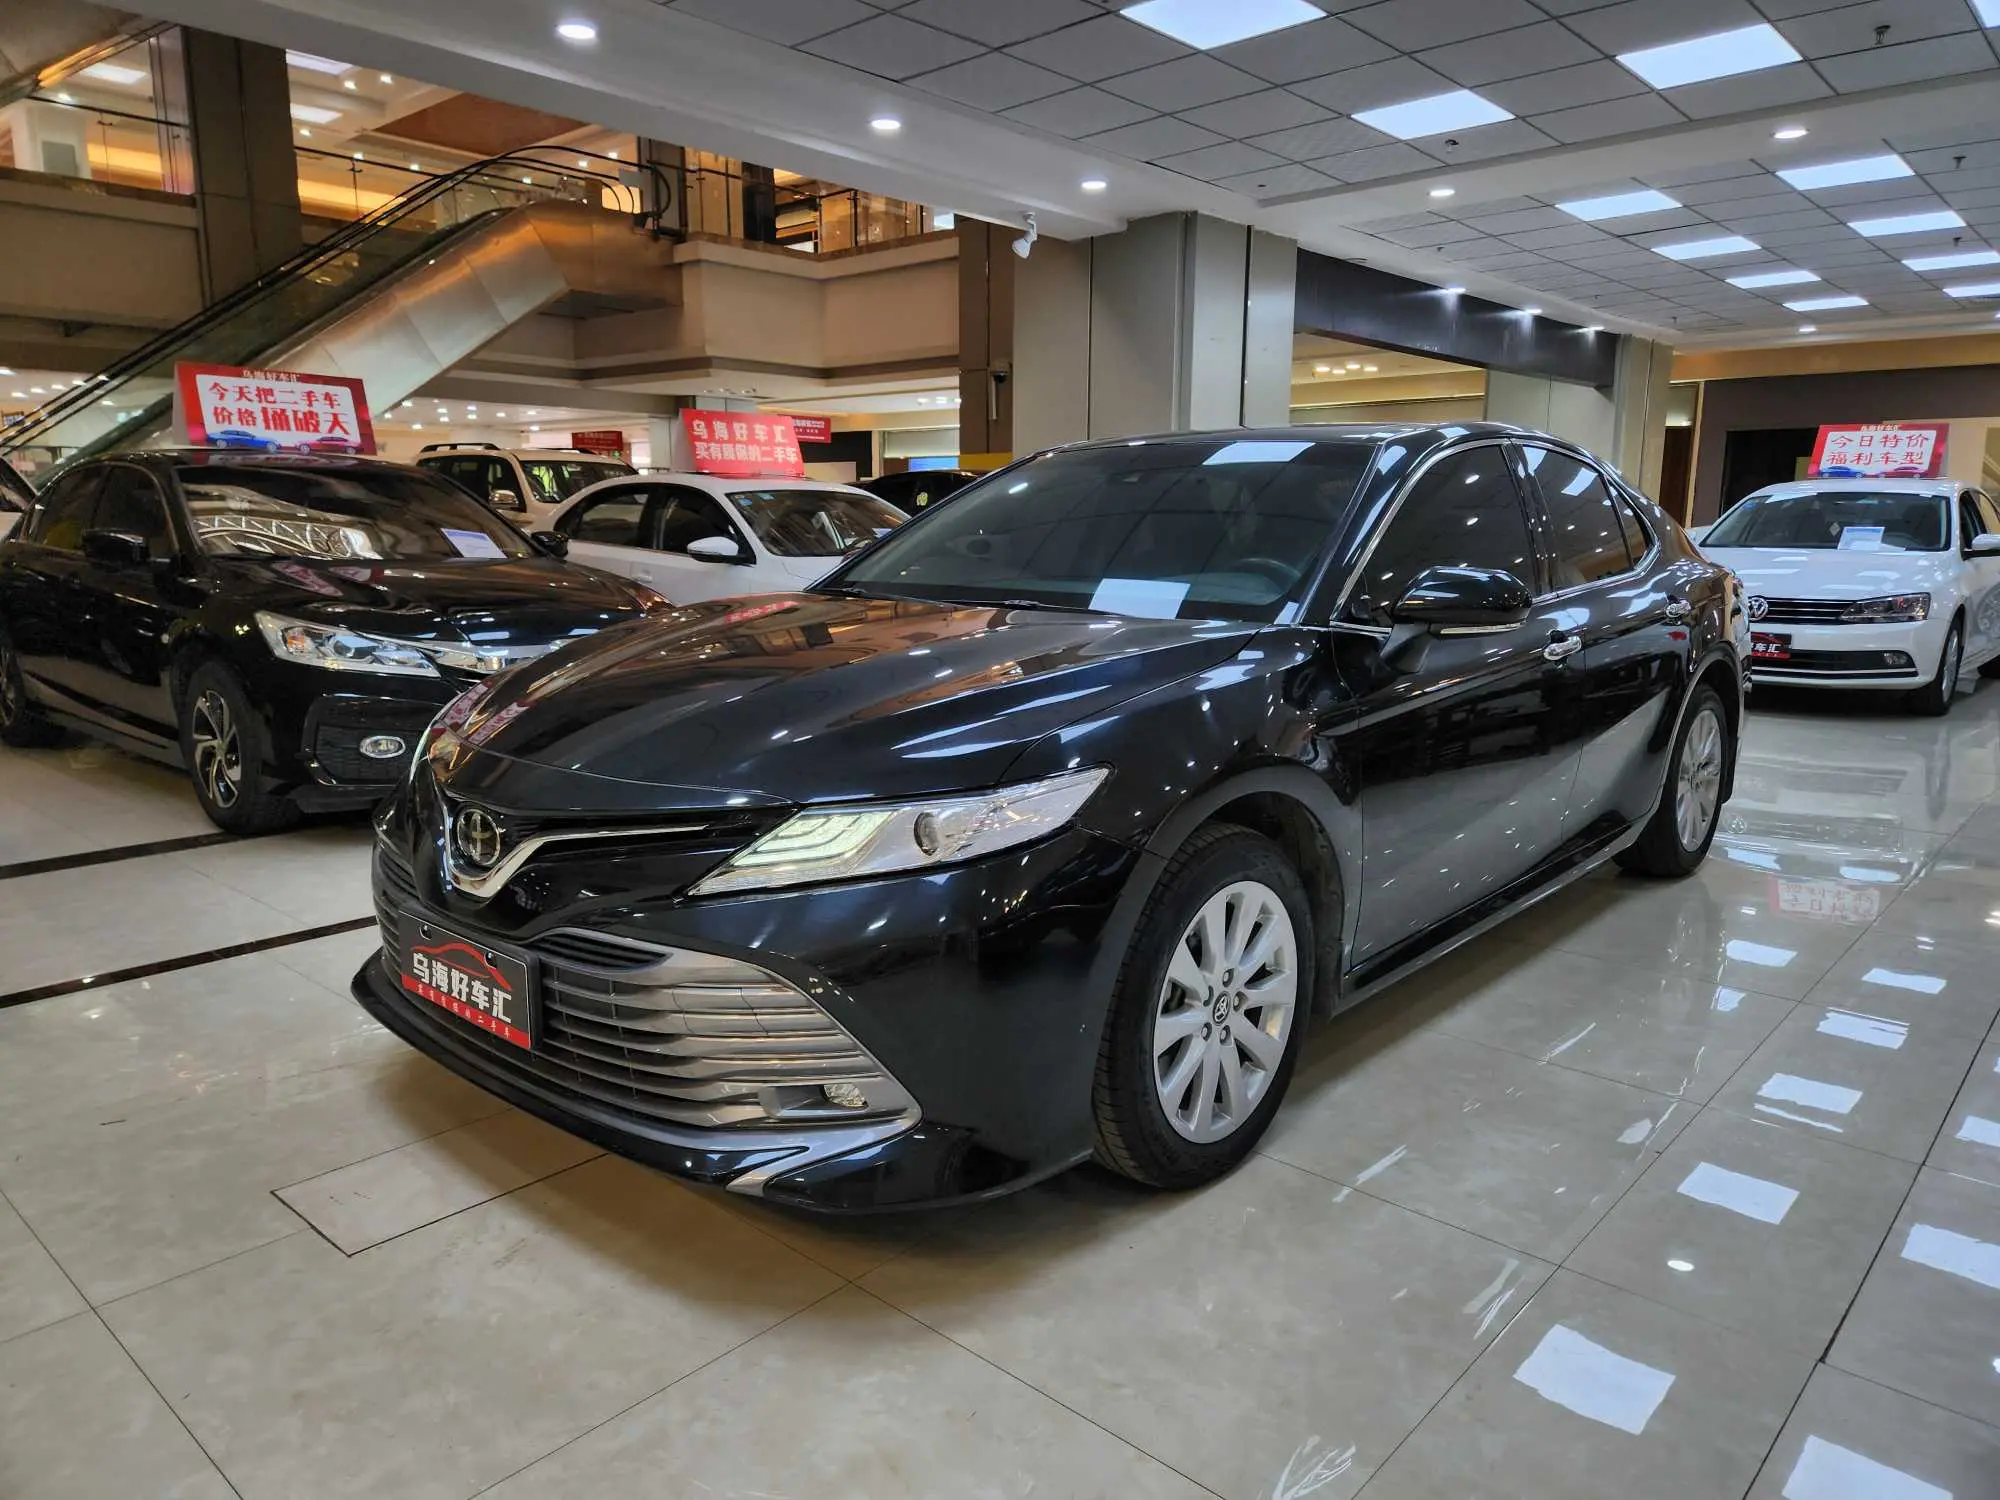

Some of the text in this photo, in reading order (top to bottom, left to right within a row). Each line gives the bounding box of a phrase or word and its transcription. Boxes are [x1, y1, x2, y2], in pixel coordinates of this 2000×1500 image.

[208, 381, 341, 409] 今天把二手车
[213, 406, 350, 435] 价格捅破天
[691, 418, 788, 443] 乌海好车汇
[1831, 433, 1929, 449] 今日特价
[1826, 451, 1924, 466] 福利车型
[1750, 642, 1781, 653] 车汇
[412, 952, 513, 1024] 乌海好车汇
